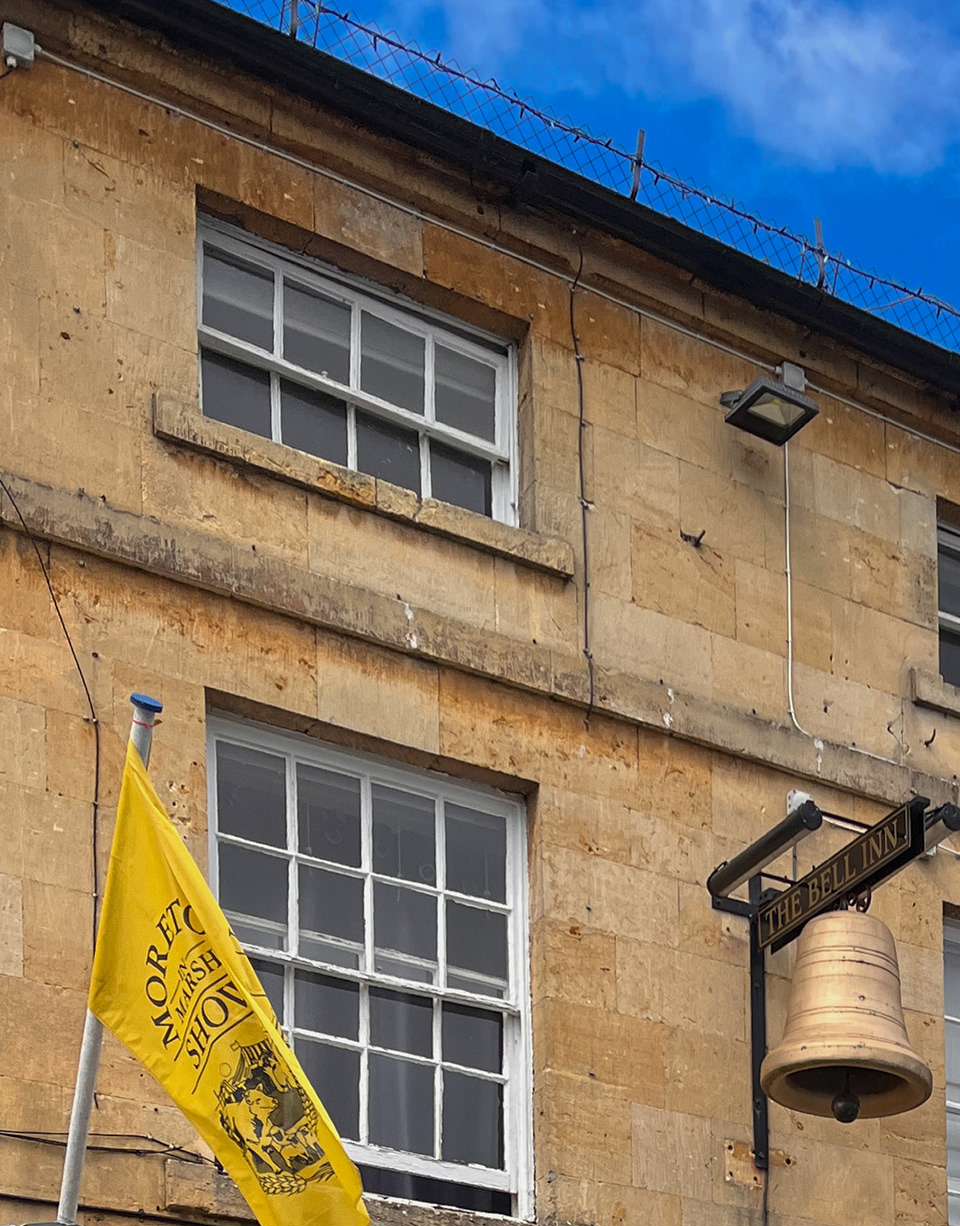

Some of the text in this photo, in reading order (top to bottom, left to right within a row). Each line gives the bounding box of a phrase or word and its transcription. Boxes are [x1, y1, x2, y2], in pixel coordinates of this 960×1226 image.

[764, 819, 899, 936] THE BELL INN
[146, 899, 206, 1050] MORETO
[175, 948, 223, 1024] MARSH
